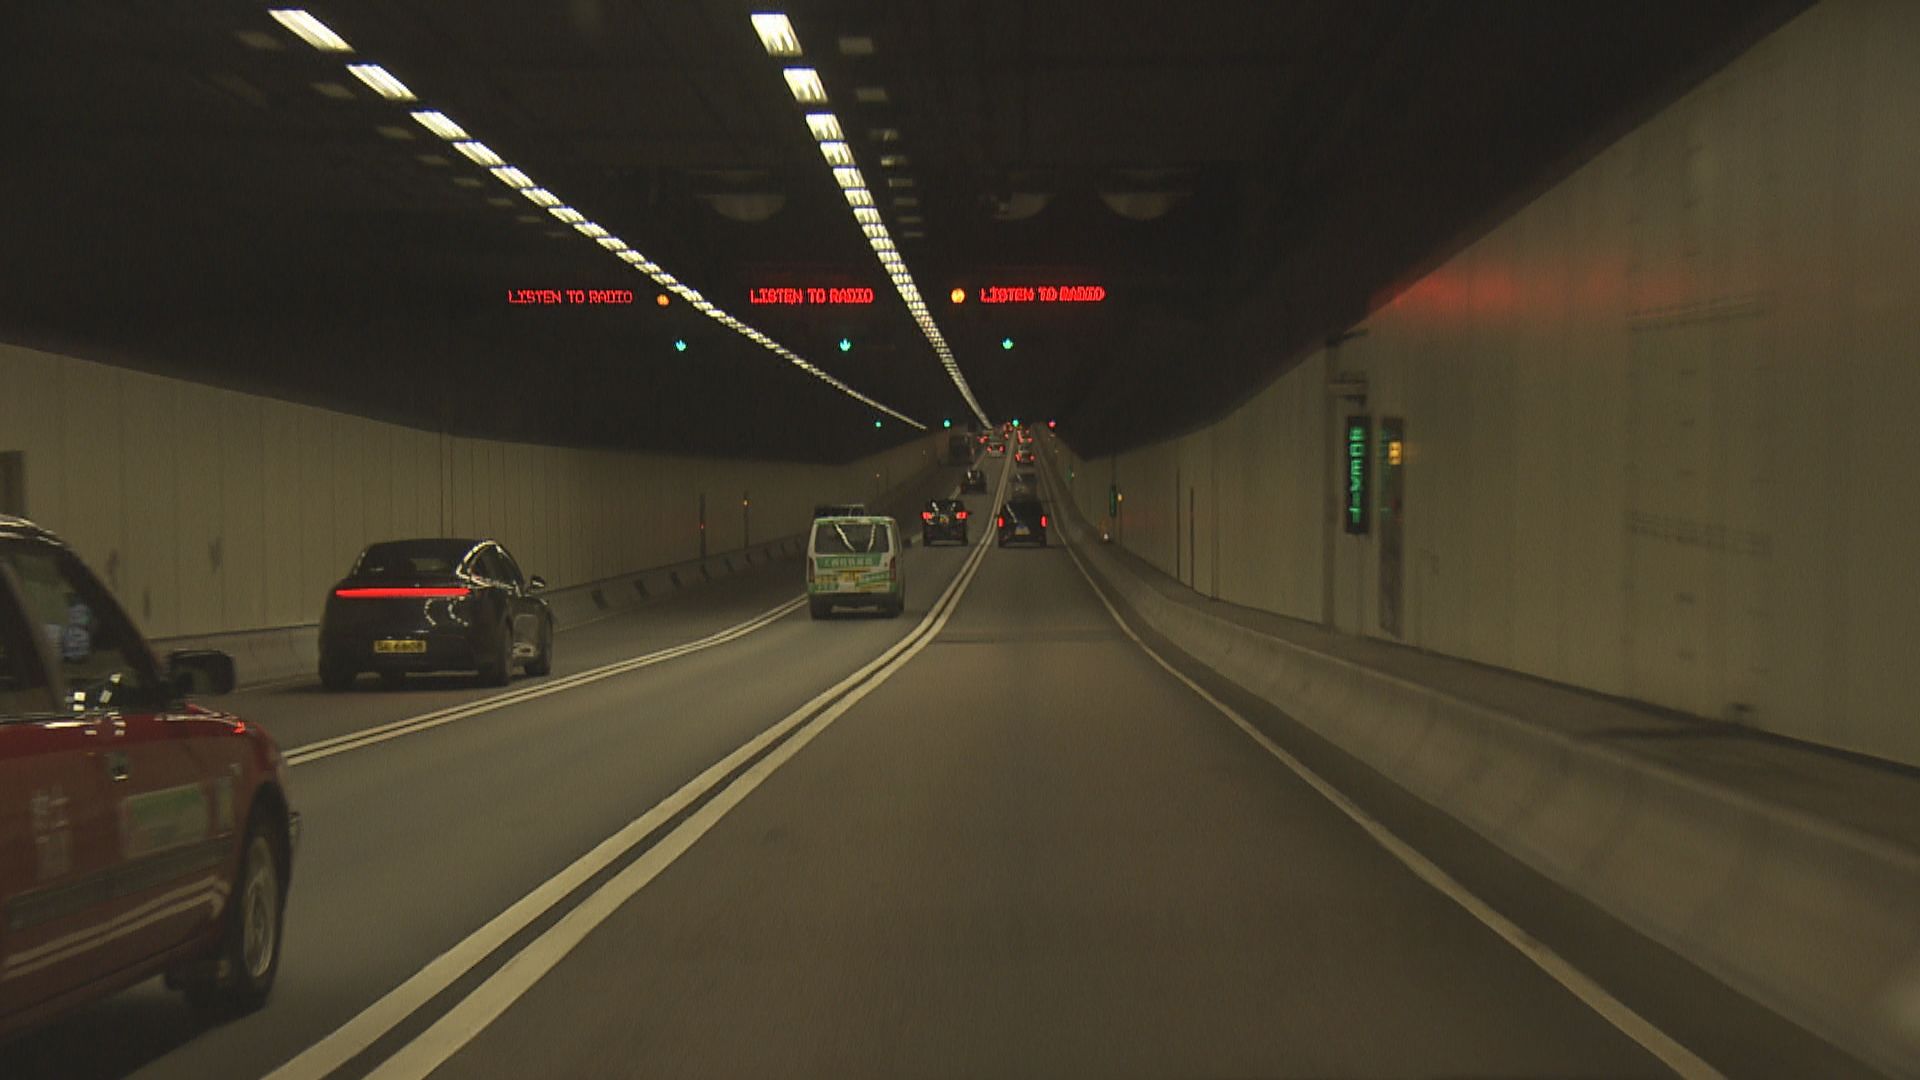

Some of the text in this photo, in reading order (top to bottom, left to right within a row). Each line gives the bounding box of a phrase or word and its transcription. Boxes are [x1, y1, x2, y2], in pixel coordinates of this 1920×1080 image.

[508, 289, 634, 304] LISTEN TO RADIO
[750, 288, 875, 304] LISTEN TO RADIO
[980, 286, 1106, 304] LISTEN TO RADIO
